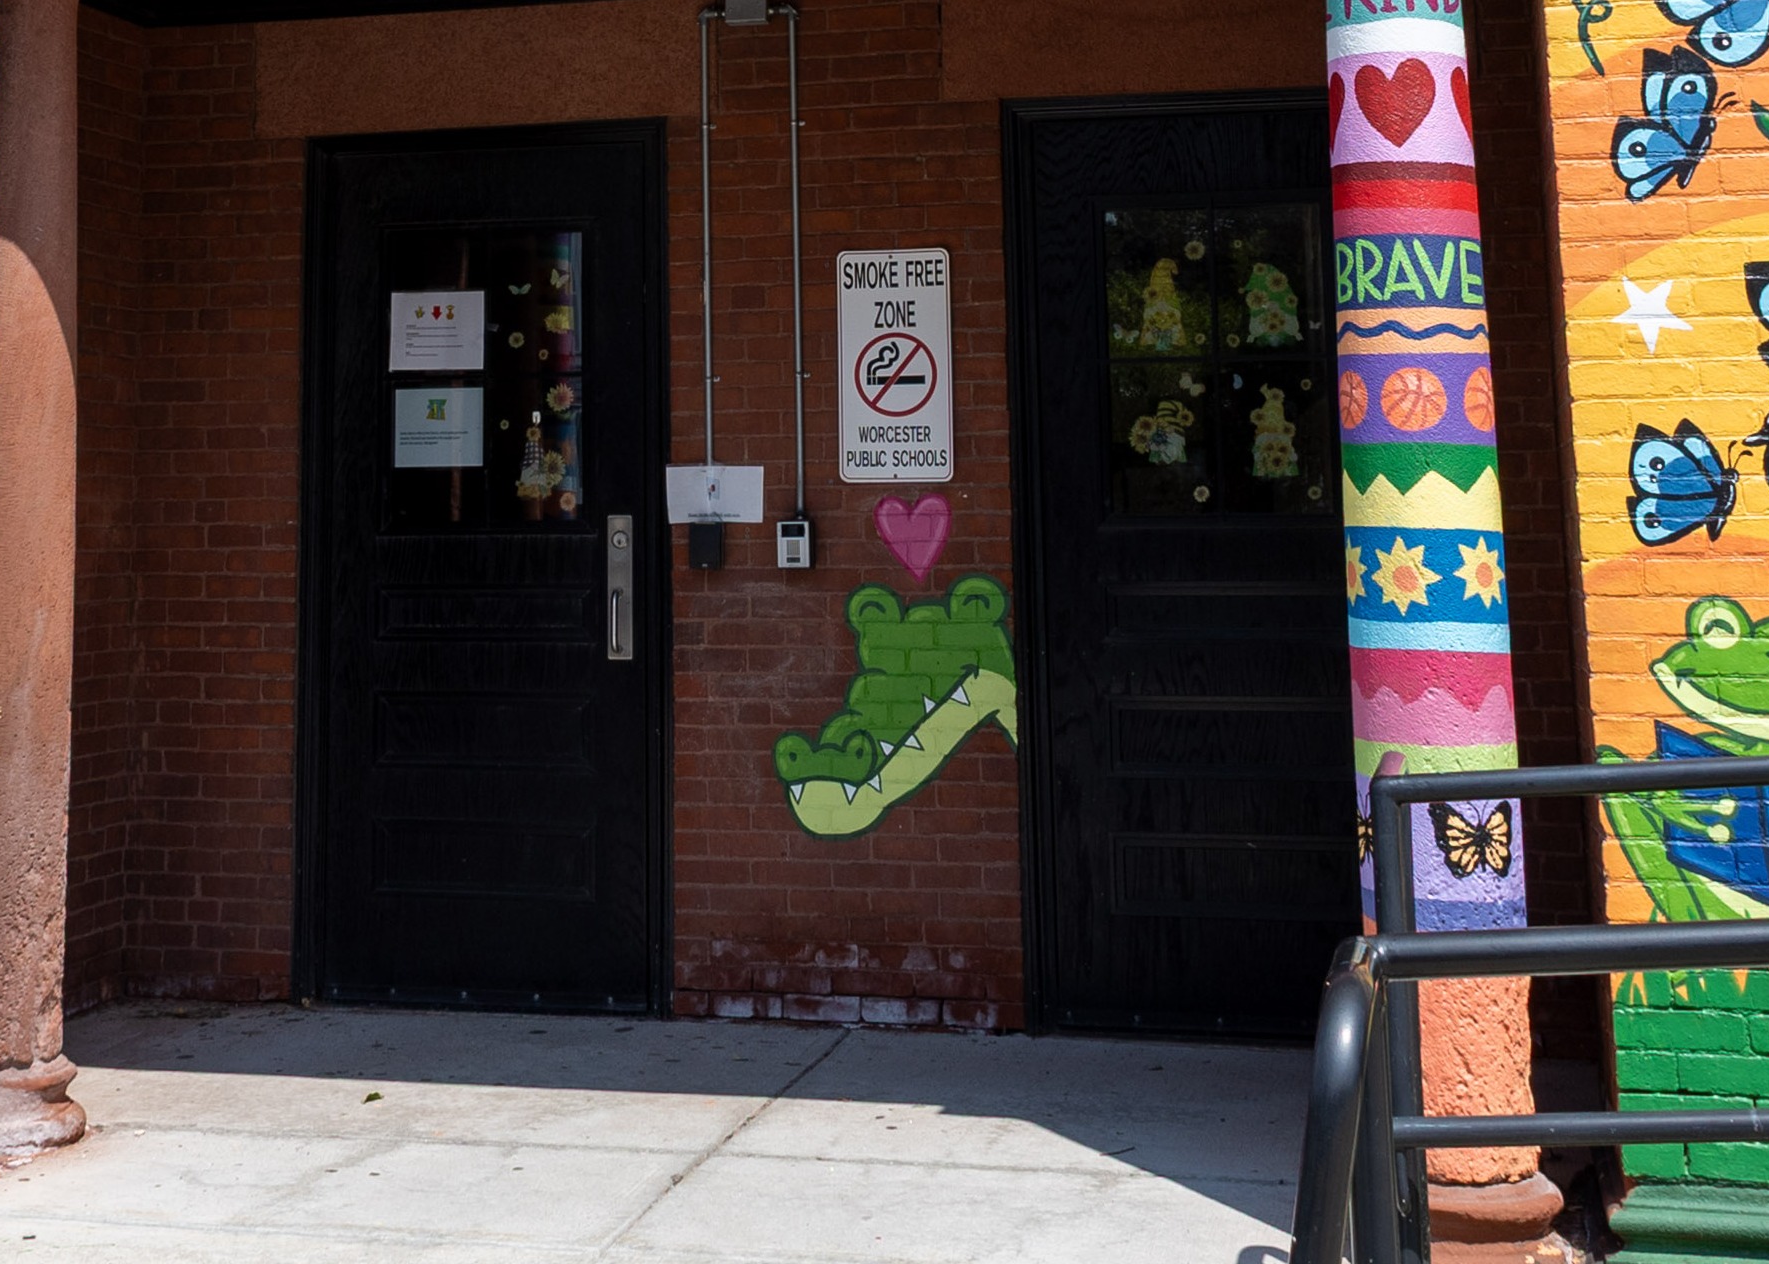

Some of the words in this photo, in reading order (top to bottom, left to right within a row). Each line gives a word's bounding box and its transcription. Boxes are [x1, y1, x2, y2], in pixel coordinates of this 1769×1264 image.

[842, 261, 900, 290] SMOKE
[905, 258, 945, 287] FREE
[1336, 237, 1485, 306] BRAVE
[873, 300, 917, 328] ZONE
[858, 425, 932, 444] WORCESTER
[846, 450, 887, 468] PUBLIC
[892, 449, 948, 468] SCHOOLS
